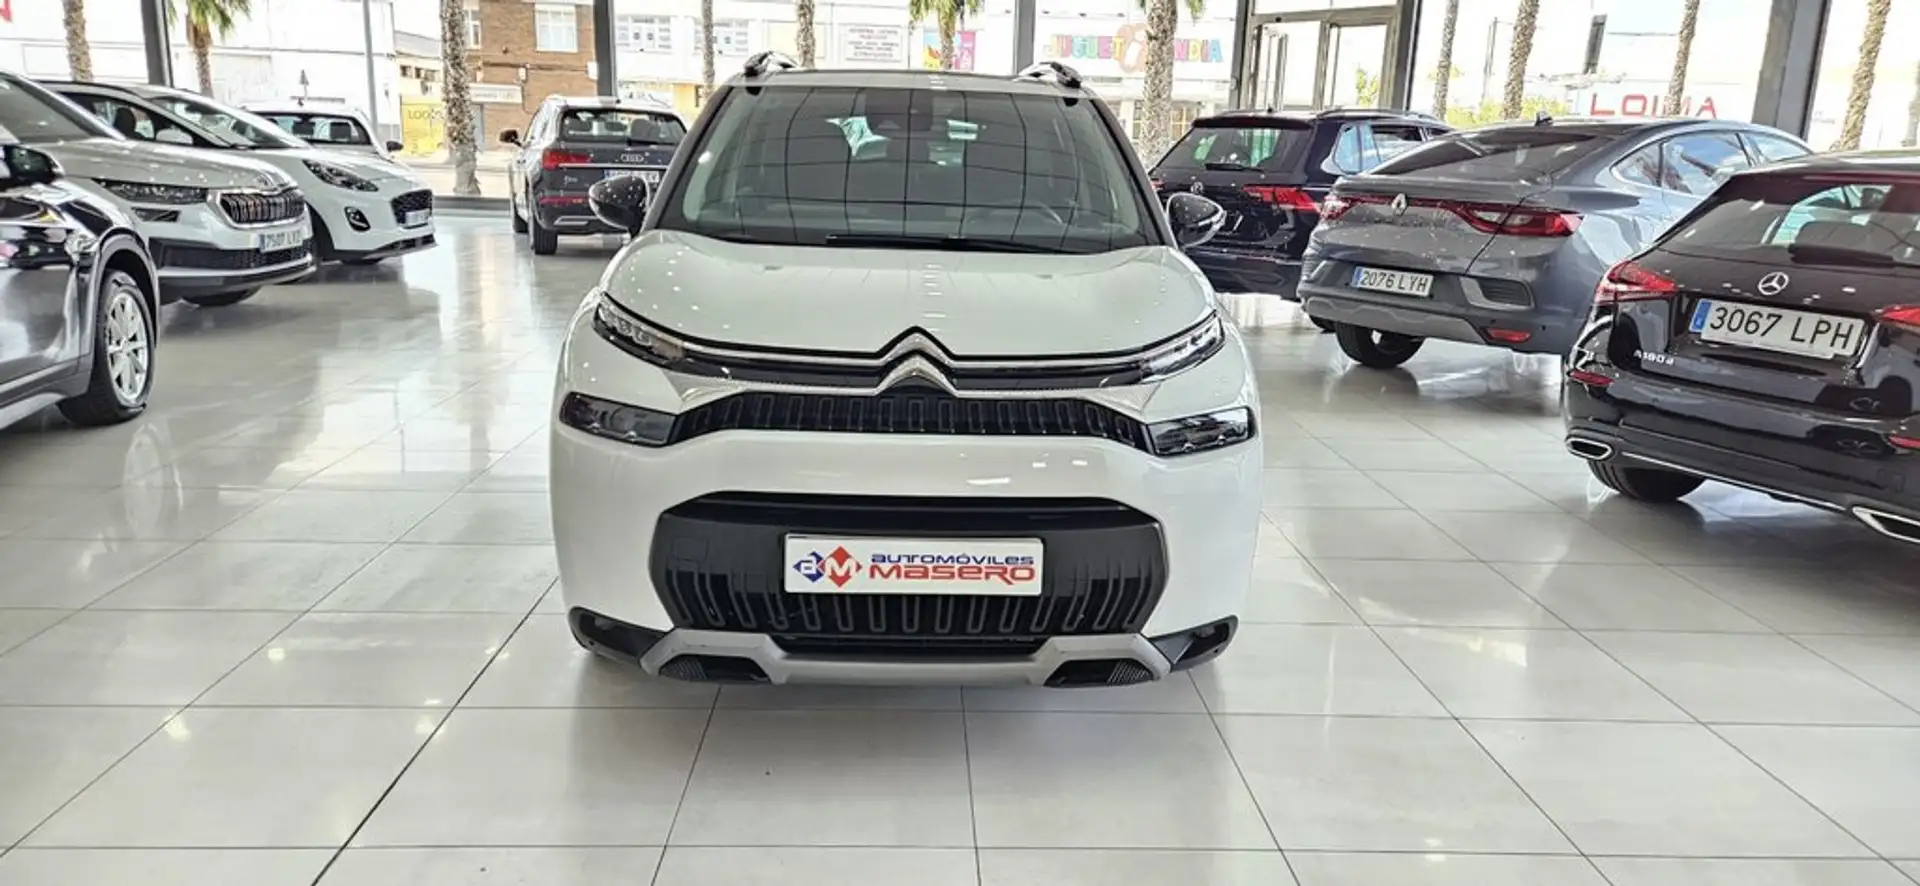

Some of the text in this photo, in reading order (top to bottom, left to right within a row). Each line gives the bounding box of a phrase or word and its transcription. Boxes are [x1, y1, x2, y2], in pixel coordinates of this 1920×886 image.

[1361, 269, 1428, 292] 2076 LYH
[1710, 306, 1854, 349] 3067 LPH
